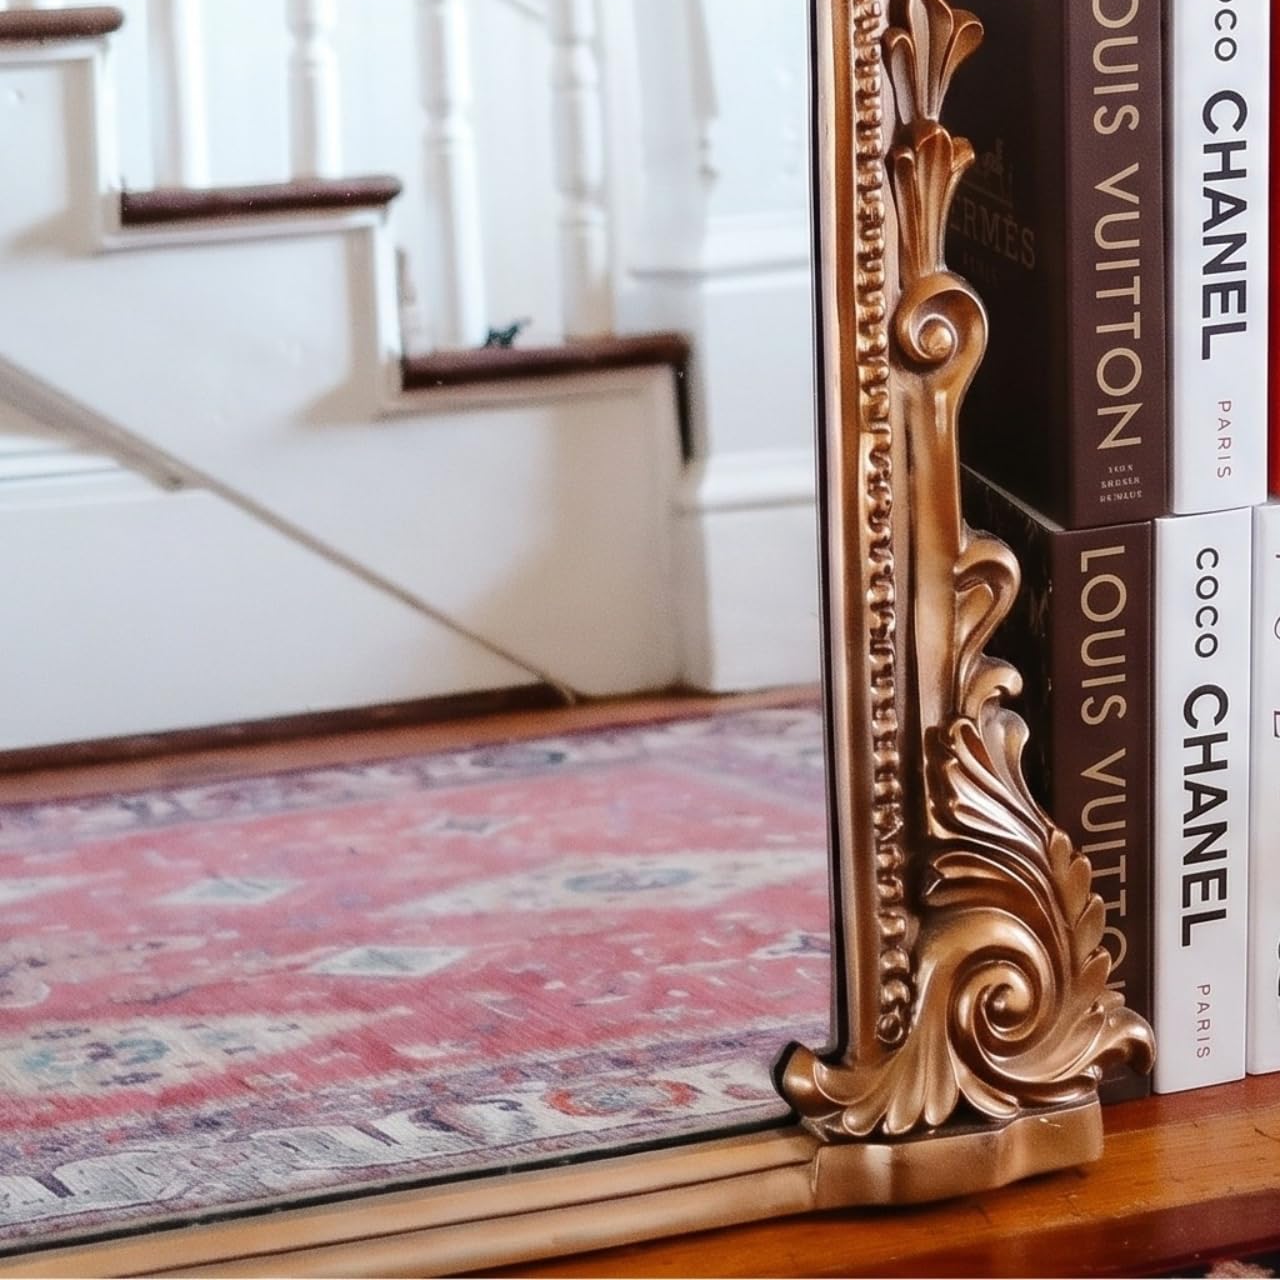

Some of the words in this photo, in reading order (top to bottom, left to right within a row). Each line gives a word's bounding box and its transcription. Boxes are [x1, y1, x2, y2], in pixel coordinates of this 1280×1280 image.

[1094, 162, 1143, 450] VUITTON
[1201, 89, 1248, 361] CHANEL
[1216, 400, 1232, 479] PARIS
[1080, 545, 1127, 725] LOUIS
[1194, 547, 1219, 658] COCO
[1181, 684, 1229, 948] CHANEL
[1196, 983, 1211, 1059] PARIS
